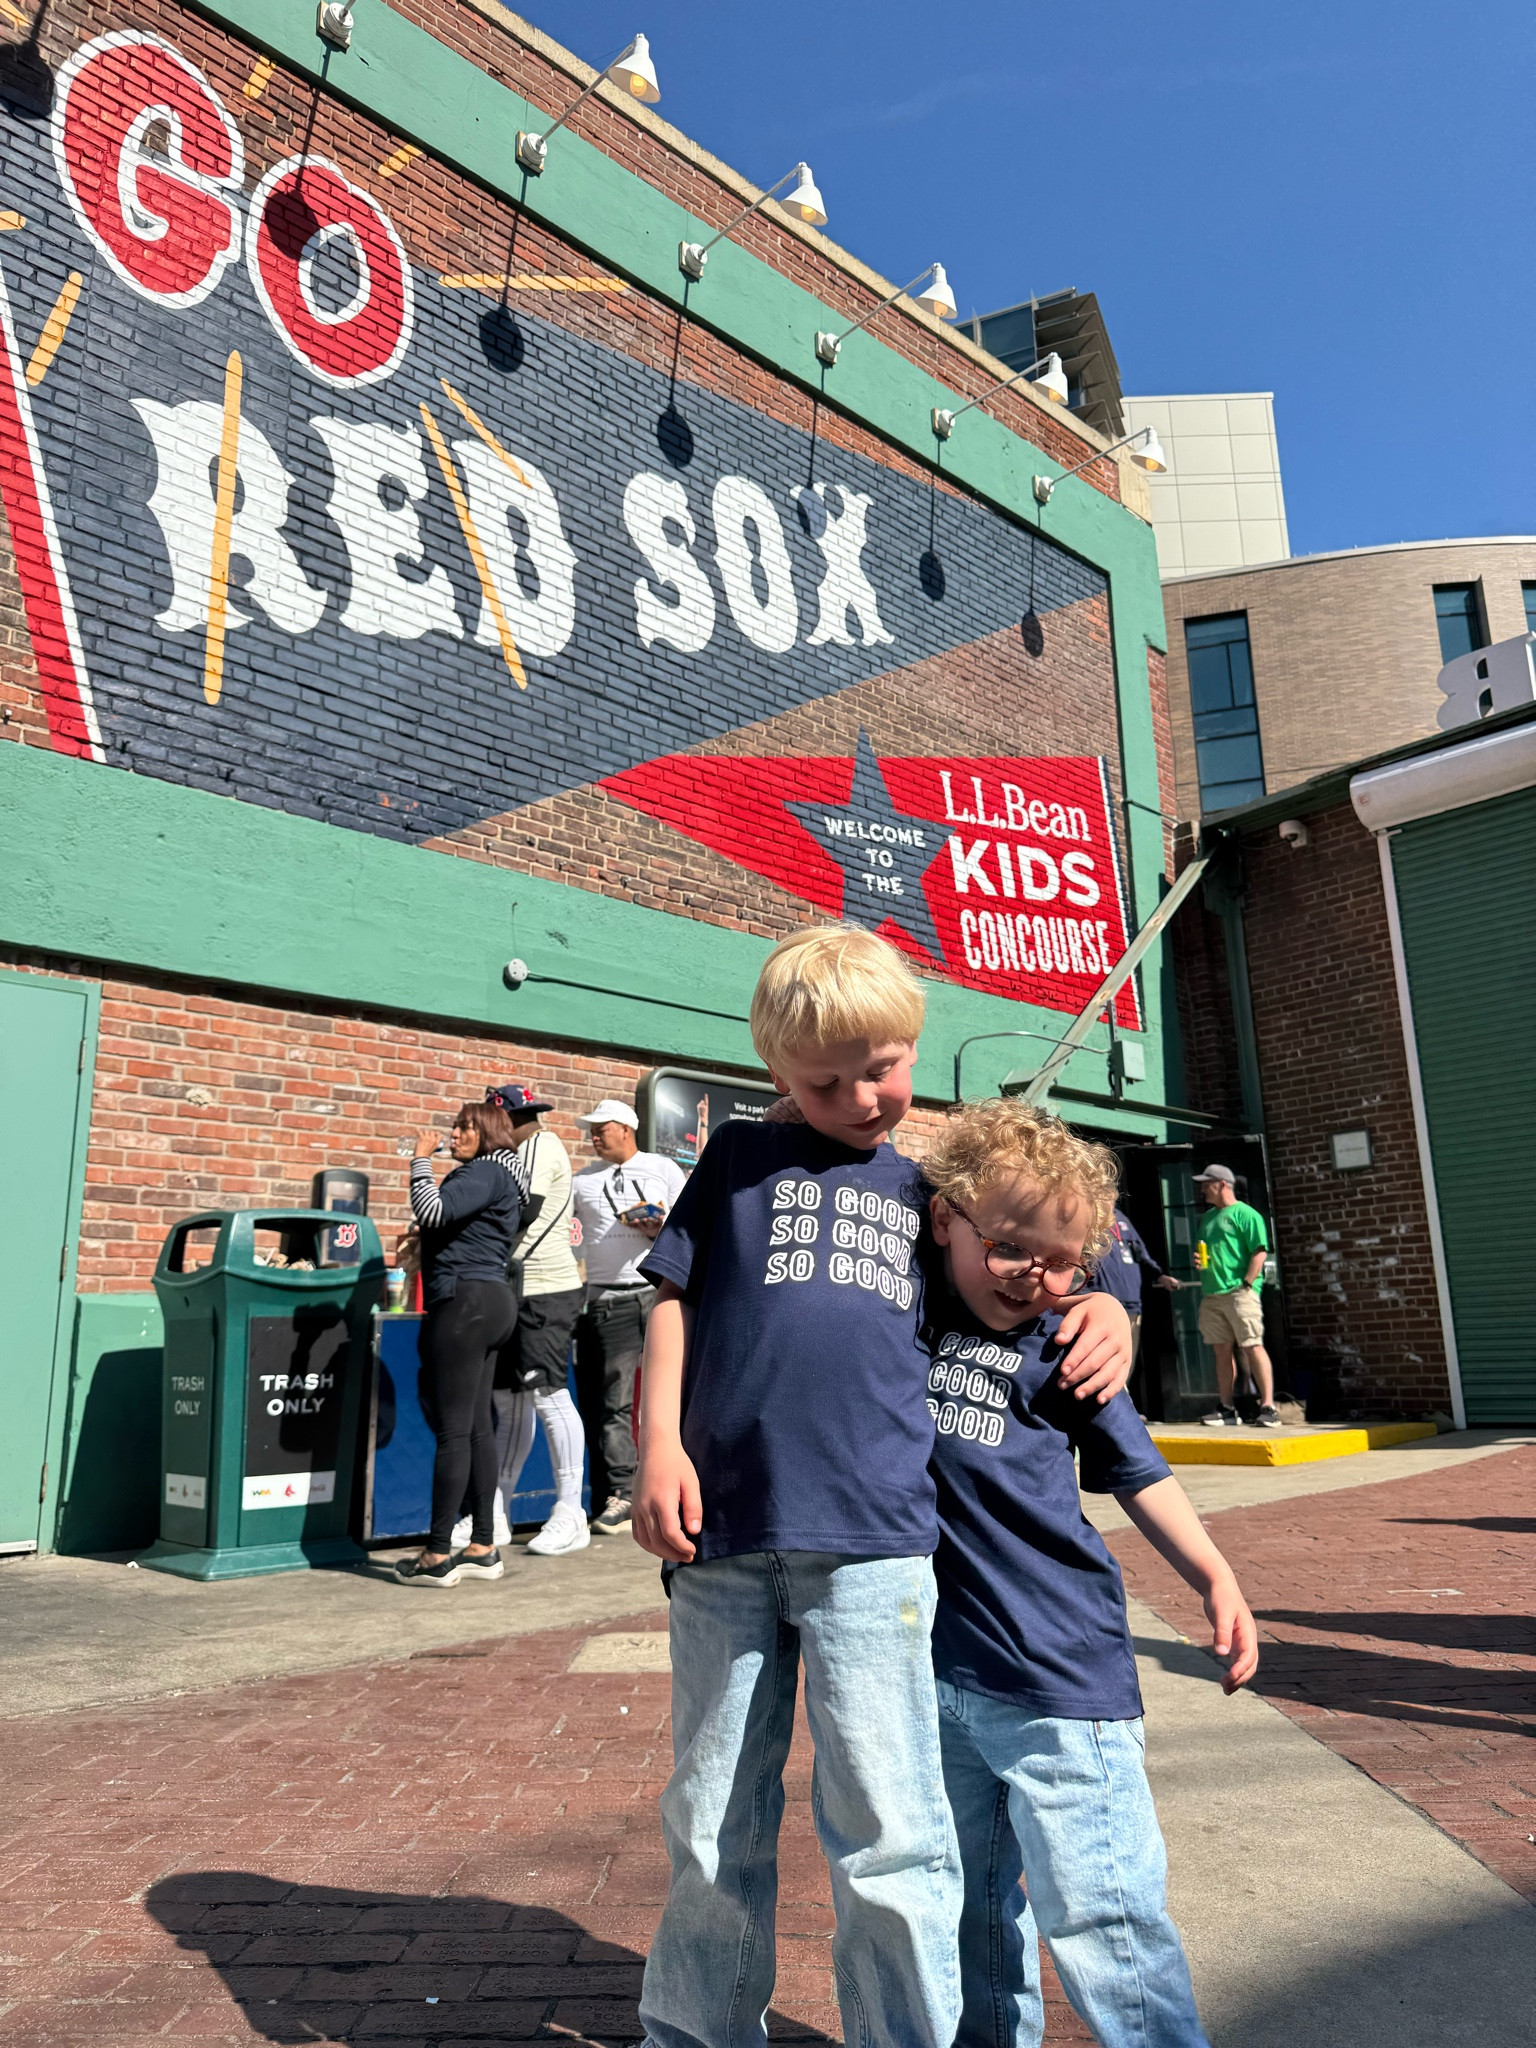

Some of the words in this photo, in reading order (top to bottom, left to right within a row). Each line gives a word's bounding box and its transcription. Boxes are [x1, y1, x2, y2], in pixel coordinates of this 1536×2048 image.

[51, 28, 415, 389] GO
[129, 398, 579, 657] RED
[622, 471, 895, 653] SOX
[939, 770, 1092, 842] L.L.Bean
[823, 816, 926, 848] WELCOME
[865, 848, 894, 868] TO
[948, 835, 1101, 907] KIDS
[861, 873, 904, 896] THE
[960, 909, 1114, 975] CONCOURSE
[772, 1179, 822, 1210] SO
[835, 1187, 920, 1240] GOOD
[769, 1214, 819, 1246] SO
[832, 1218, 911, 1275] GOOD
[764, 1249, 815, 1285] SO
[828, 1252, 913, 1310] GOOD
[938, 1331, 1023, 1374] GOOD
[171, 1376, 206, 1392] TRASH
[259, 1373, 335, 1392] TRASH
[928, 1361, 1012, 1409] GOOD
[174, 1399, 201, 1416] ONLY
[266, 1397, 326, 1417] ONLY
[496, 1950, 516, 1958] OF
[519, 1950, 549, 1958] POP
